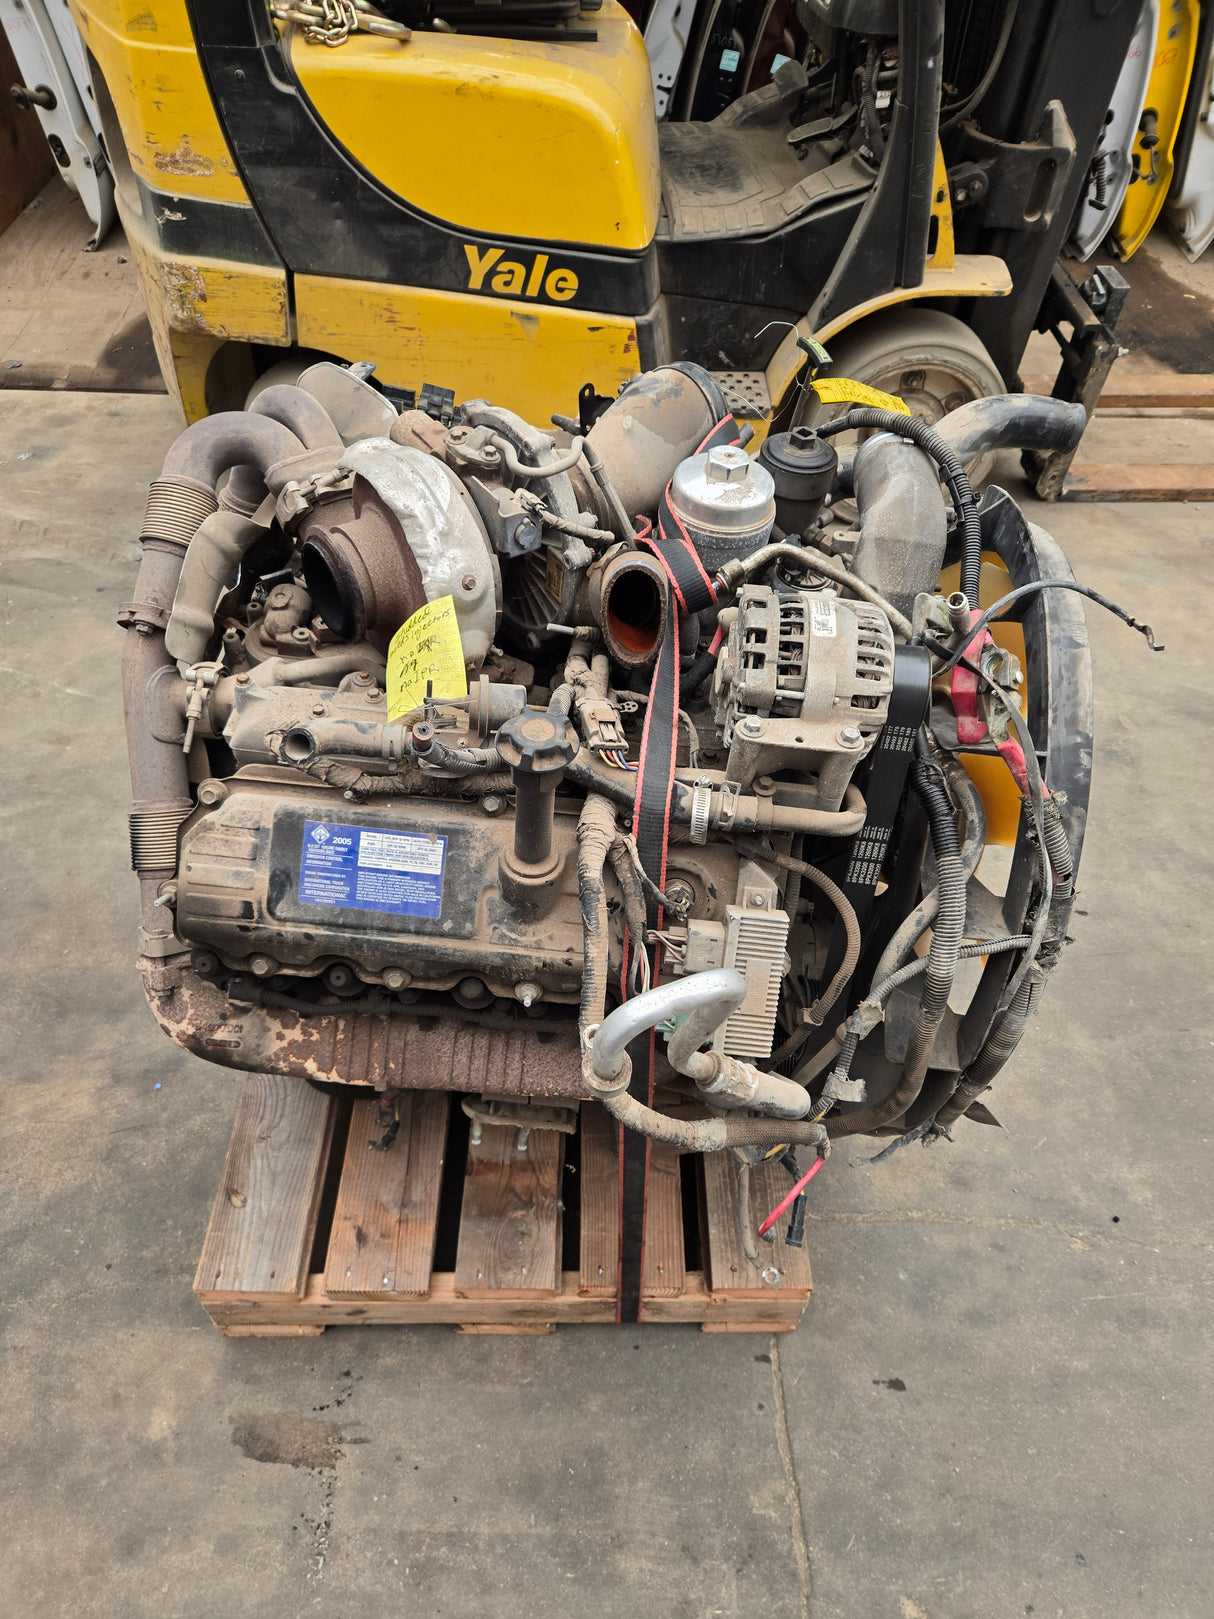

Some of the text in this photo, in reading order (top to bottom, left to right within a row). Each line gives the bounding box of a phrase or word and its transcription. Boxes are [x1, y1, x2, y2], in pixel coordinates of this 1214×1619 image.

[464, 244, 579, 301] Yale
[333, 837, 352, 845] 2005
[305, 889, 347, 898] INTERNATIONAL
